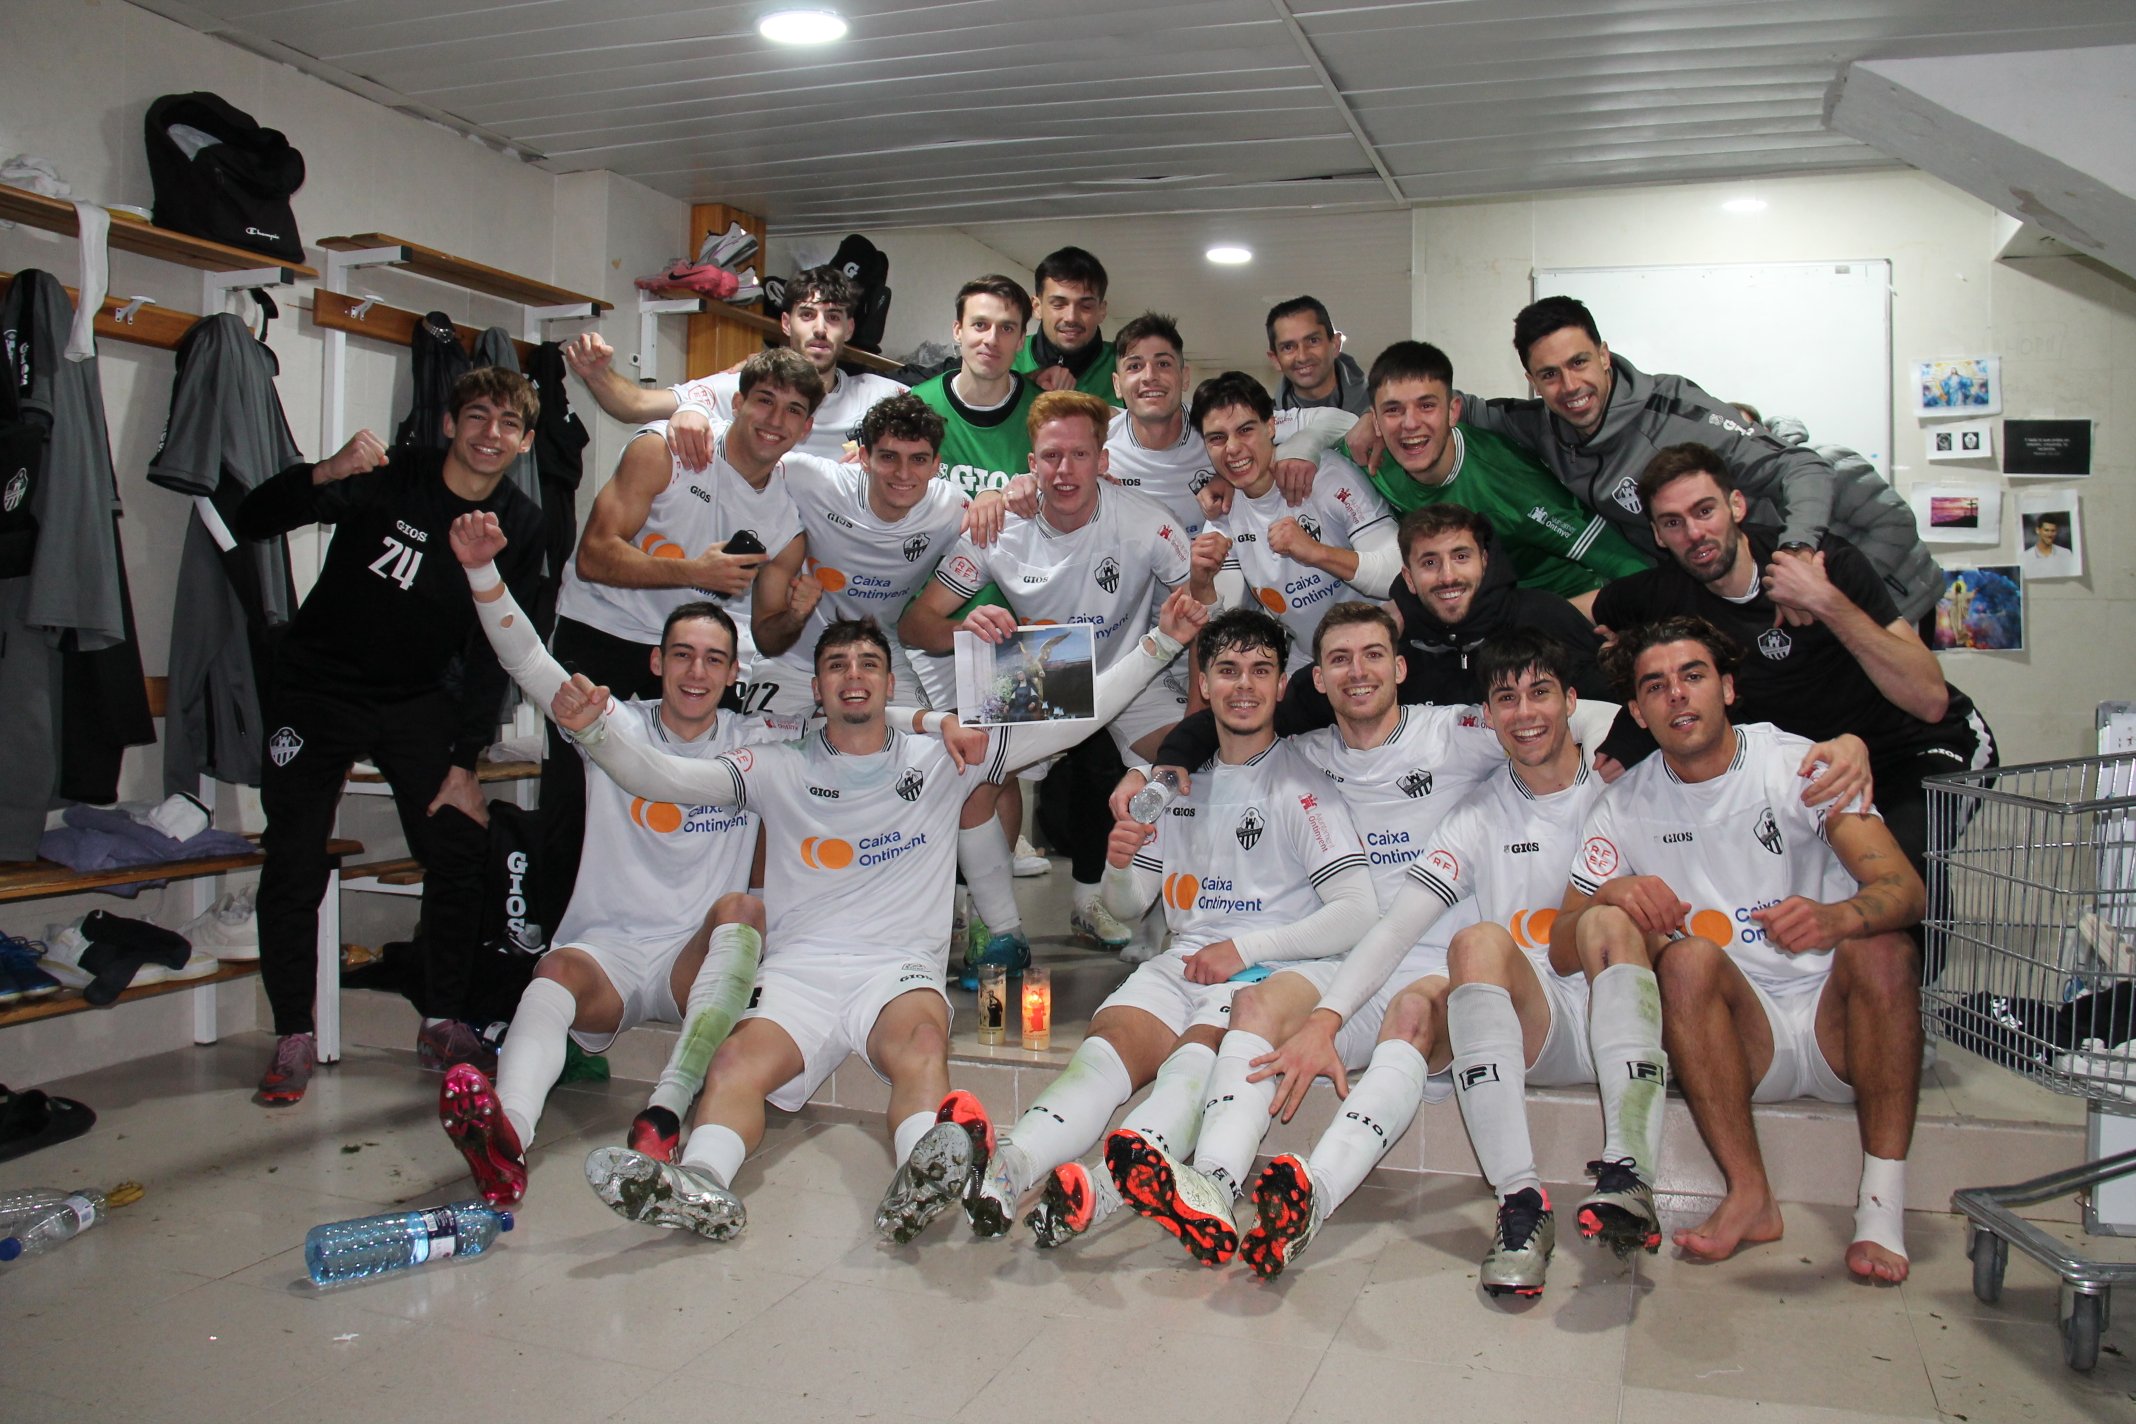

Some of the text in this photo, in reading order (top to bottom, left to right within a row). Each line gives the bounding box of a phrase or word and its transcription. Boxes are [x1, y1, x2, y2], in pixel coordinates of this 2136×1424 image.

[950, 464, 1010, 492] GIO
[1119, 479, 1141, 487] IOS
[690, 485, 711, 503] GIOS
[396, 520, 428, 542] GIOS
[368, 536, 423, 591] 24
[852, 575, 891, 587] Caixa
[1285, 574, 1321, 594] Caixa
[1292, 580, 1341, 608] Ontinye
[809, 787, 839, 799] GIOS
[684, 815, 748, 833] Ontinyent
[859, 831, 900, 849] Caixa
[1309, 815, 1328, 852] Ontinyent
[1367, 829, 1410, 846] Caixa
[1370, 848, 1424, 864] Ontiny
[1201, 876, 1233, 891] Caixa
[1198, 896, 1262, 913] Ontinyent
